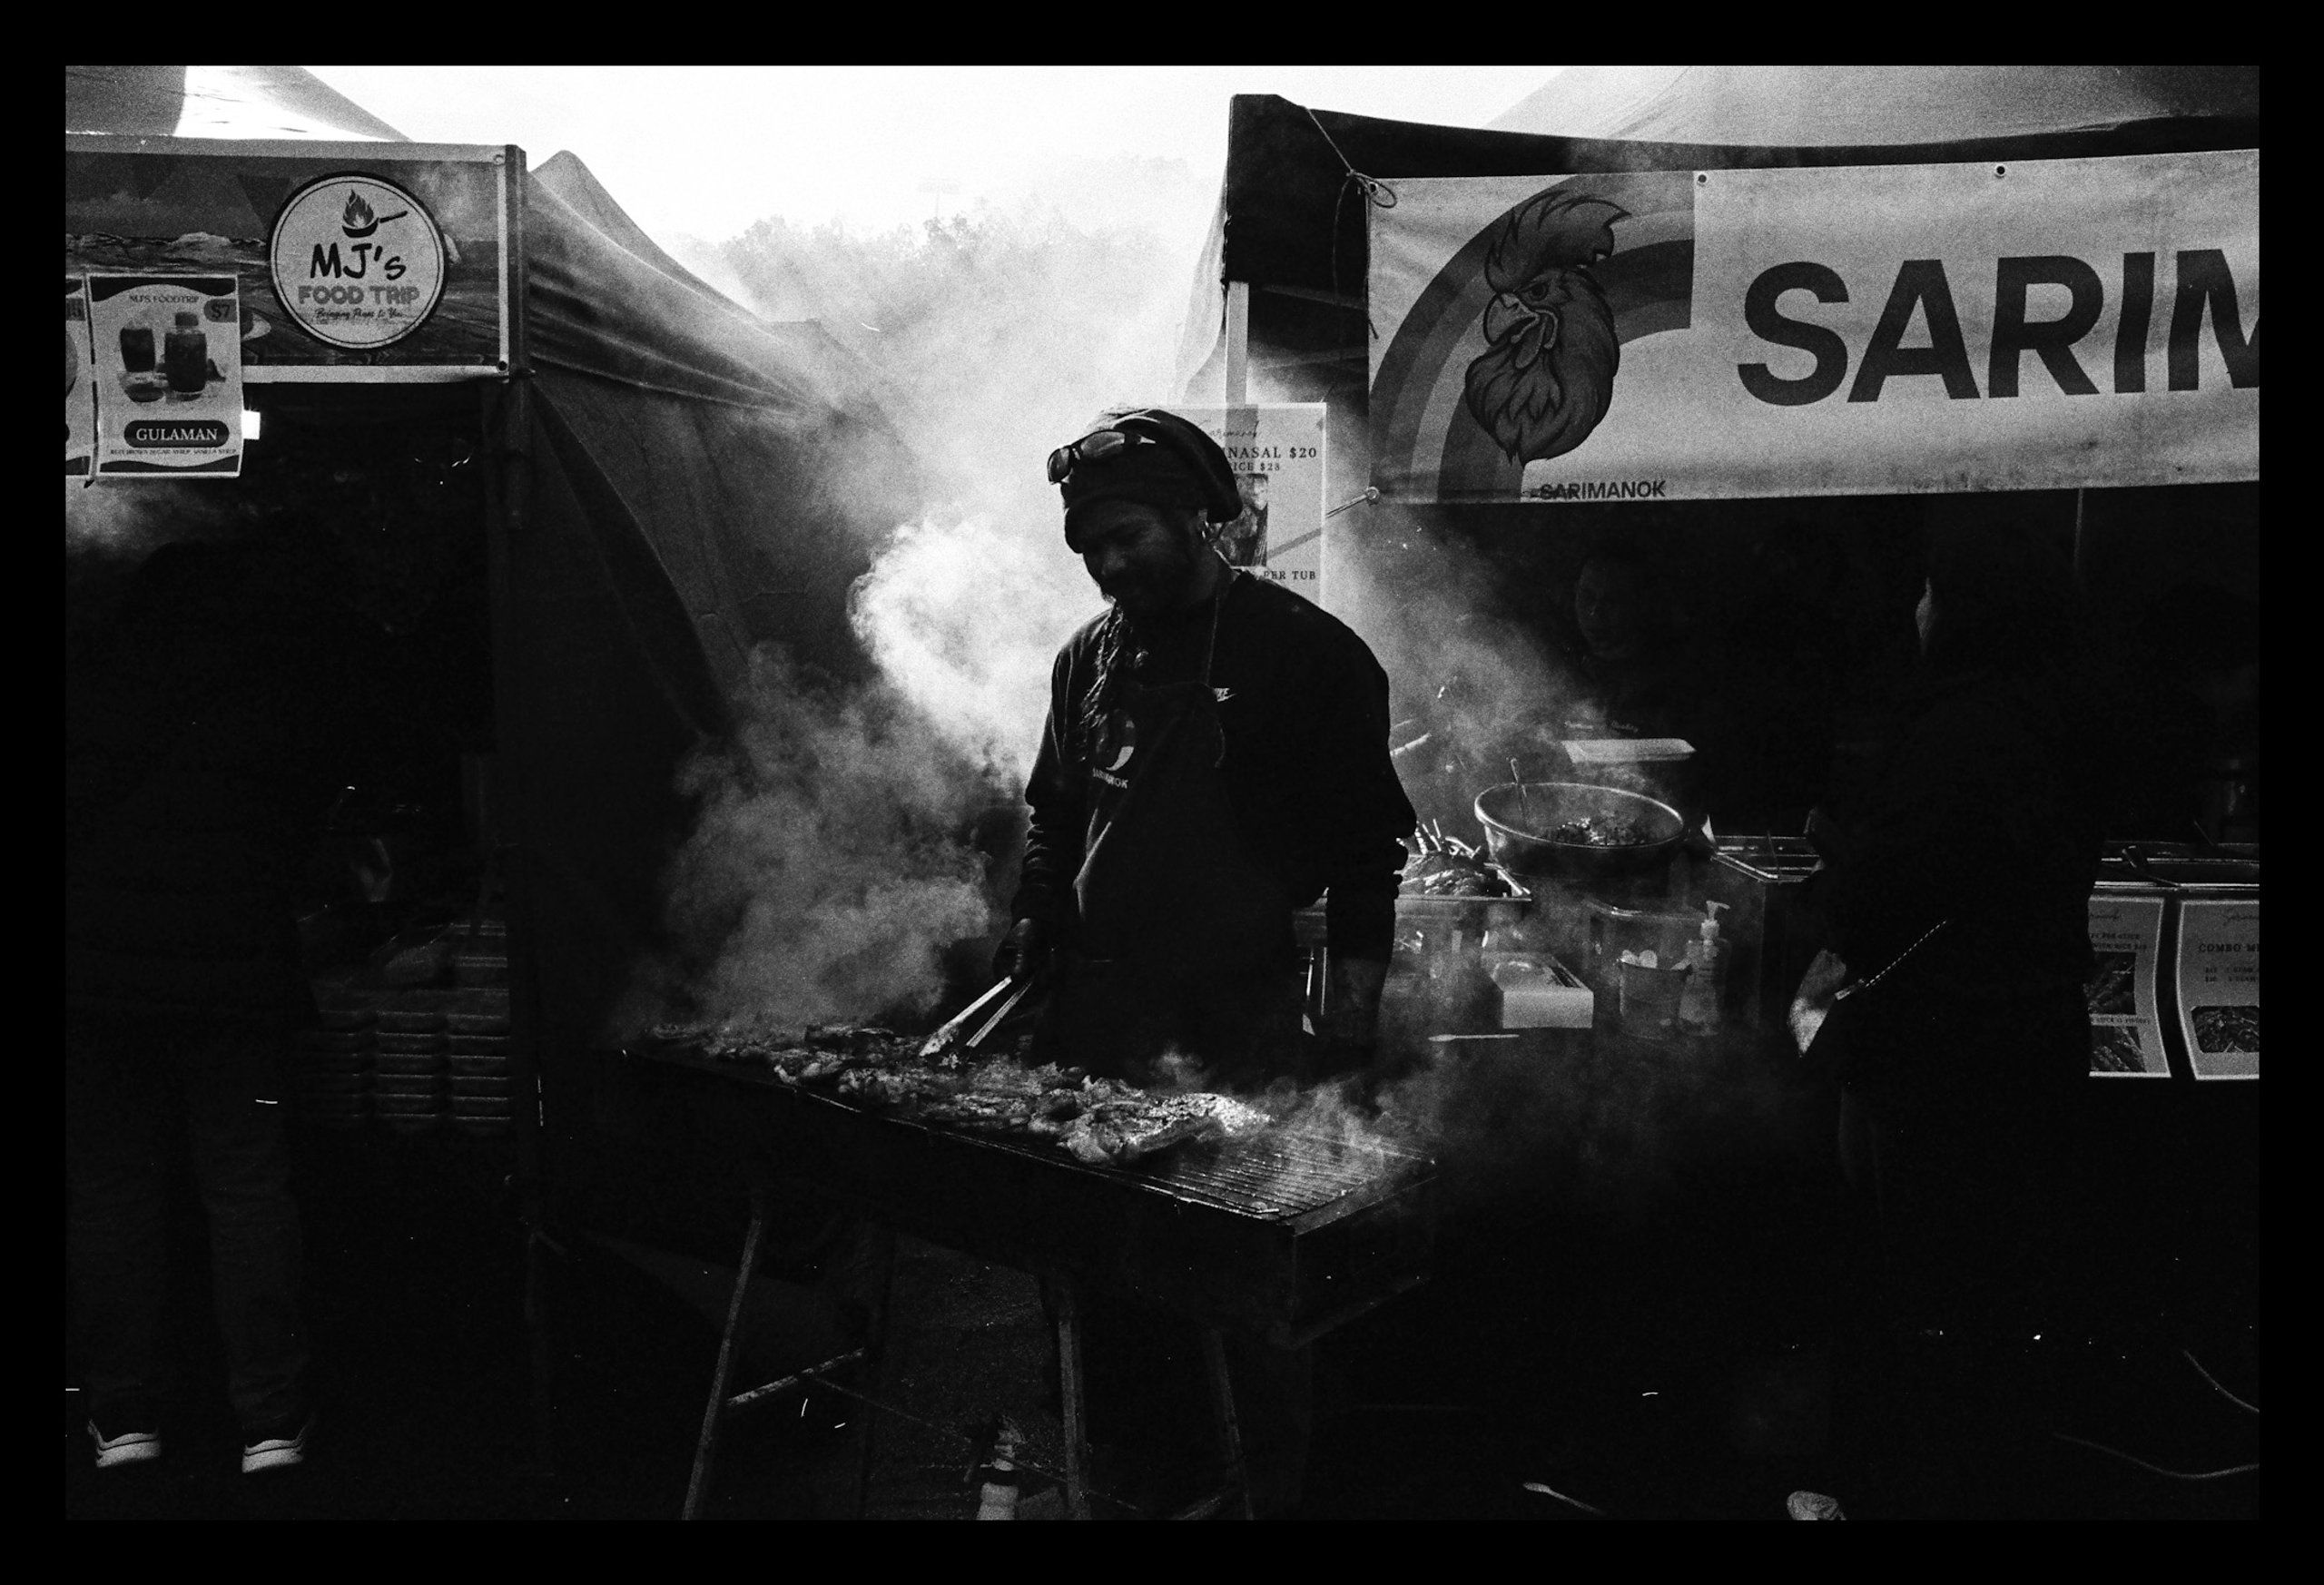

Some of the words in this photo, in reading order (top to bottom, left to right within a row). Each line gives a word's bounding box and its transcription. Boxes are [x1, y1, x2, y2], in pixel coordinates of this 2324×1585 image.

[310, 241, 407, 281] MJ's
[298, 285, 364, 305] FOOD
[369, 285, 420, 305] TRIP
[211, 303, 231, 319] $7
[1737, 249, 2260, 407] SARIM
[136, 428, 218, 441] GULAMAN
[1222, 447, 1281, 458] NASAL
[1289, 447, 1317, 458] $20
[1231, 462, 1254, 471] ICE
[1541, 480, 1666, 499] SARIMANOK
[1292, 570, 1316, 580] TUB
[2199, 943, 2239, 953] COMBO
